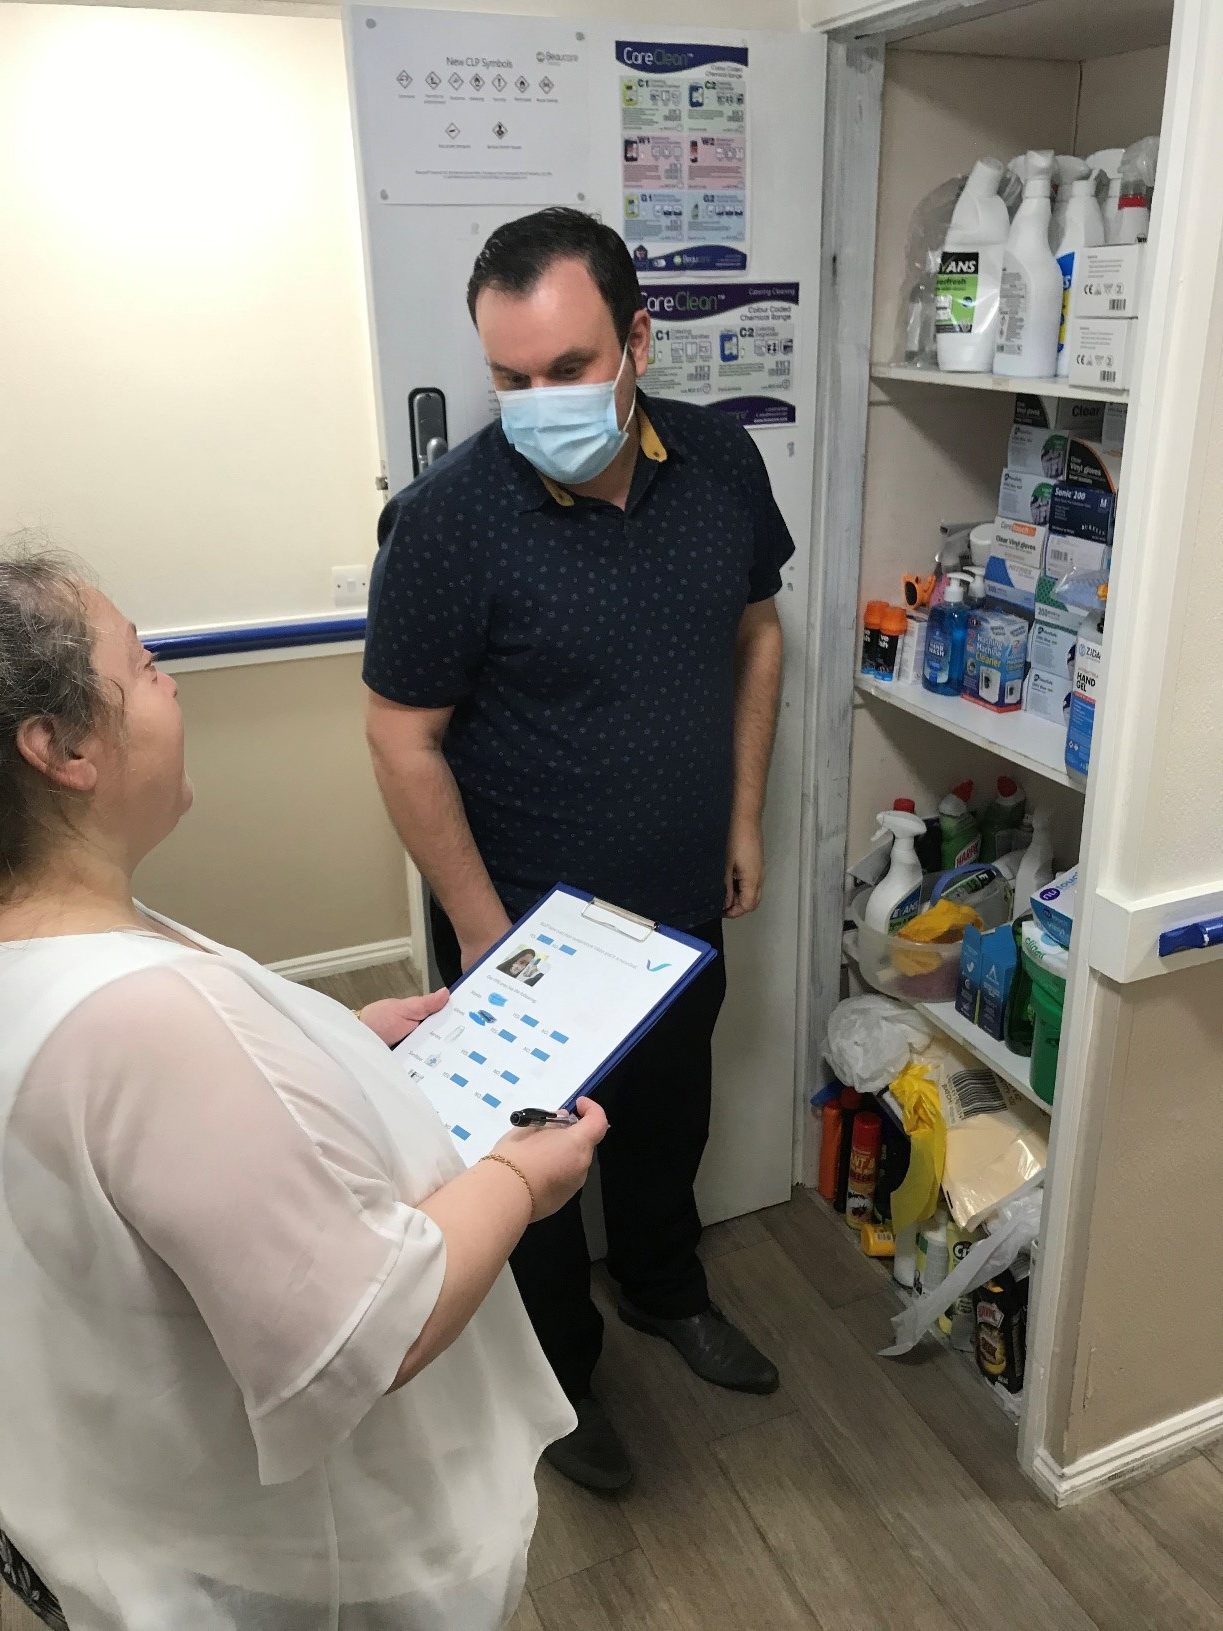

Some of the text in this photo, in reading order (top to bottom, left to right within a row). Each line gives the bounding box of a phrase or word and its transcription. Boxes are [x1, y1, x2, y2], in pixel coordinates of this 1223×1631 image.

[446, 57, 513, 69] New CLP Symbols
[656, 330, 670, 341] C1
[739, 327, 754, 338] C2
[1072, 405, 1099, 418] Clear
[1055, 487, 1071, 499] Sonic
[975, 651, 1001, 668] Cleaner
[1076, 671, 1096, 687] HAND
[1076, 680, 1087, 692] GEL
